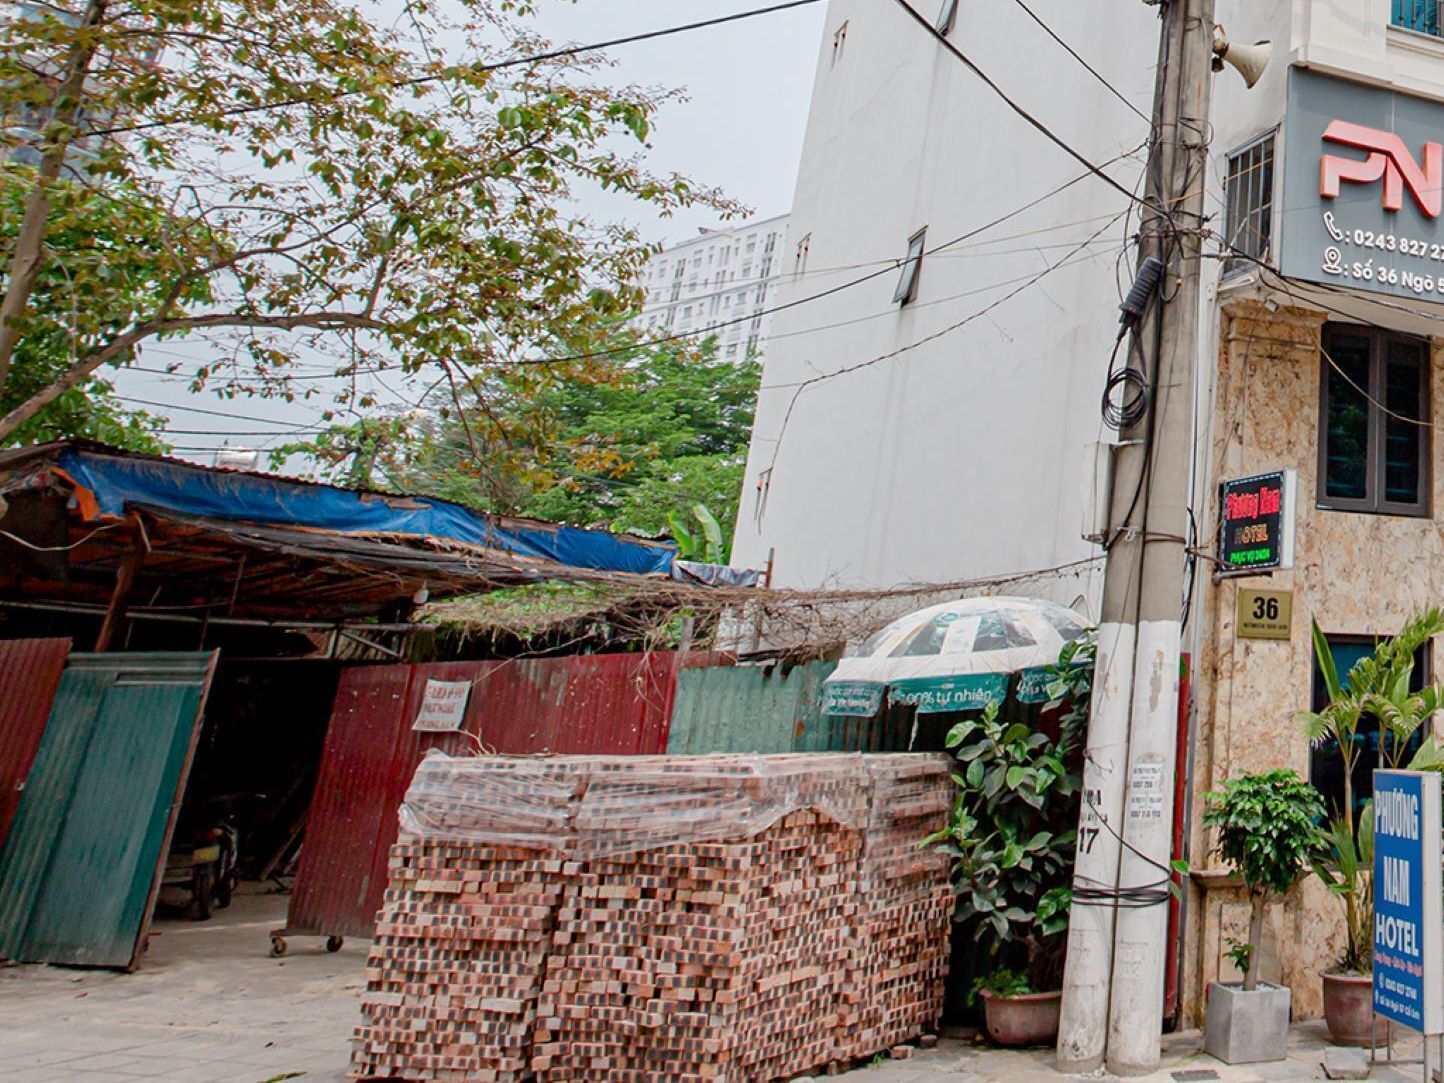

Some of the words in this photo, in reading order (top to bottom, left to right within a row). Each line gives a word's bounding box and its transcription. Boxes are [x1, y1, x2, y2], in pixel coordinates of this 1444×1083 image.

[1320, 120, 1443, 218] PN
[1354, 229, 1396, 251] 0243
[1399, 237, 1428, 258] 827
[1352, 259, 1373, 280] Số
[1377, 266, 1398, 285] 36
[1252, 596, 1278, 620] 36
[1079, 826, 1099, 854] 17
[1384, 856, 1410, 906] NAM
[1375, 912, 1419, 957] HOTEL
